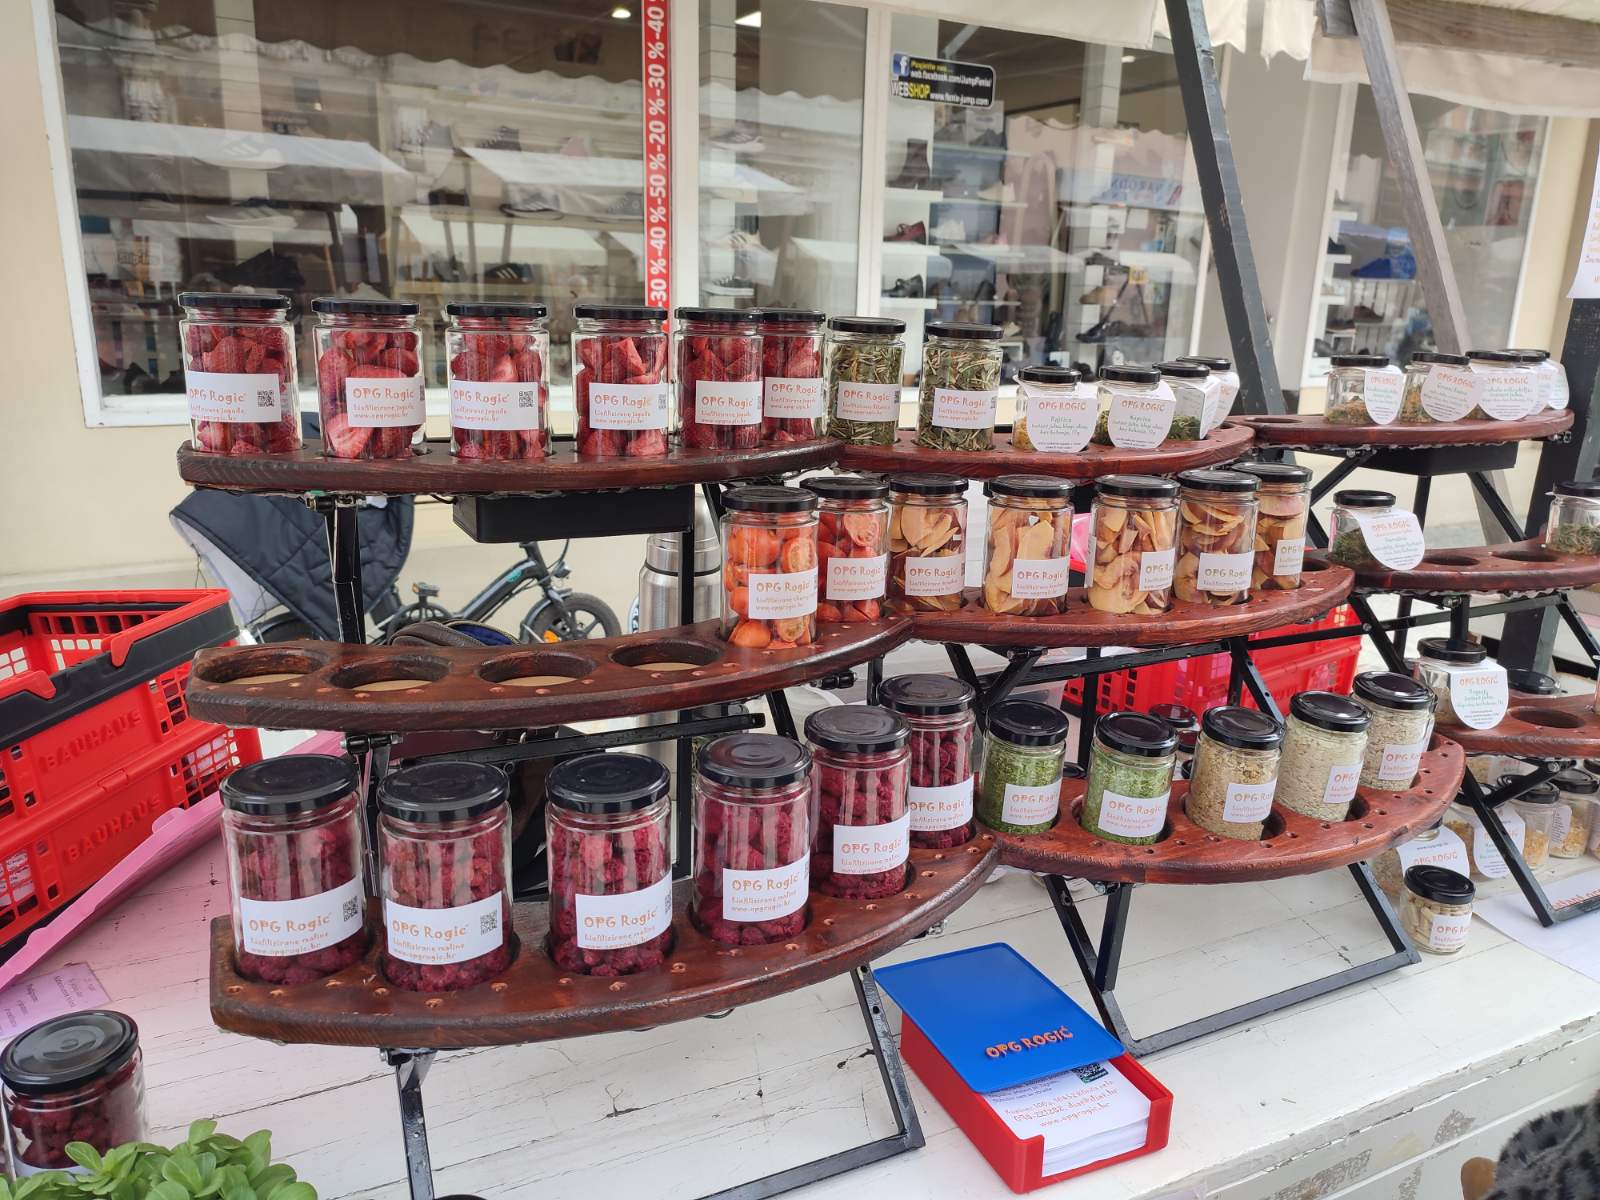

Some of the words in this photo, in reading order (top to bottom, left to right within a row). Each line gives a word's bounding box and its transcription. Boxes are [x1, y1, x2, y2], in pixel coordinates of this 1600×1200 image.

[891, 80, 931, 98] WEBSHOP
[771, 383, 792, 392] OPG
[353, 388, 380, 399] OPG
[844, 389, 863, 398] OPG
[595, 395, 618, 405] OPG
[702, 396, 724, 406] OPG
[940, 396, 959, 405] OPG
[834, 566, 856, 576] OPG
[910, 568, 931, 577] OPG
[1017, 570, 1039, 580] OPG
[1205, 568, 1226, 577] OPG
[756, 582, 781, 592] OPG
[38, 711, 142, 773] BAUHAUS
[1012, 794, 1035, 803] OPG
[1234, 792, 1258, 802] OPG
[910, 801, 935, 813] OPG
[1108, 800, 1133, 814] OPG
[841, 843, 870, 855] OPG
[732, 879, 762, 891] OPG
[249, 919, 281, 932] OPG
[584, 917, 616, 928] OPG
[392, 920, 419, 936] OPG
[986, 1041, 1022, 1058] OPG
